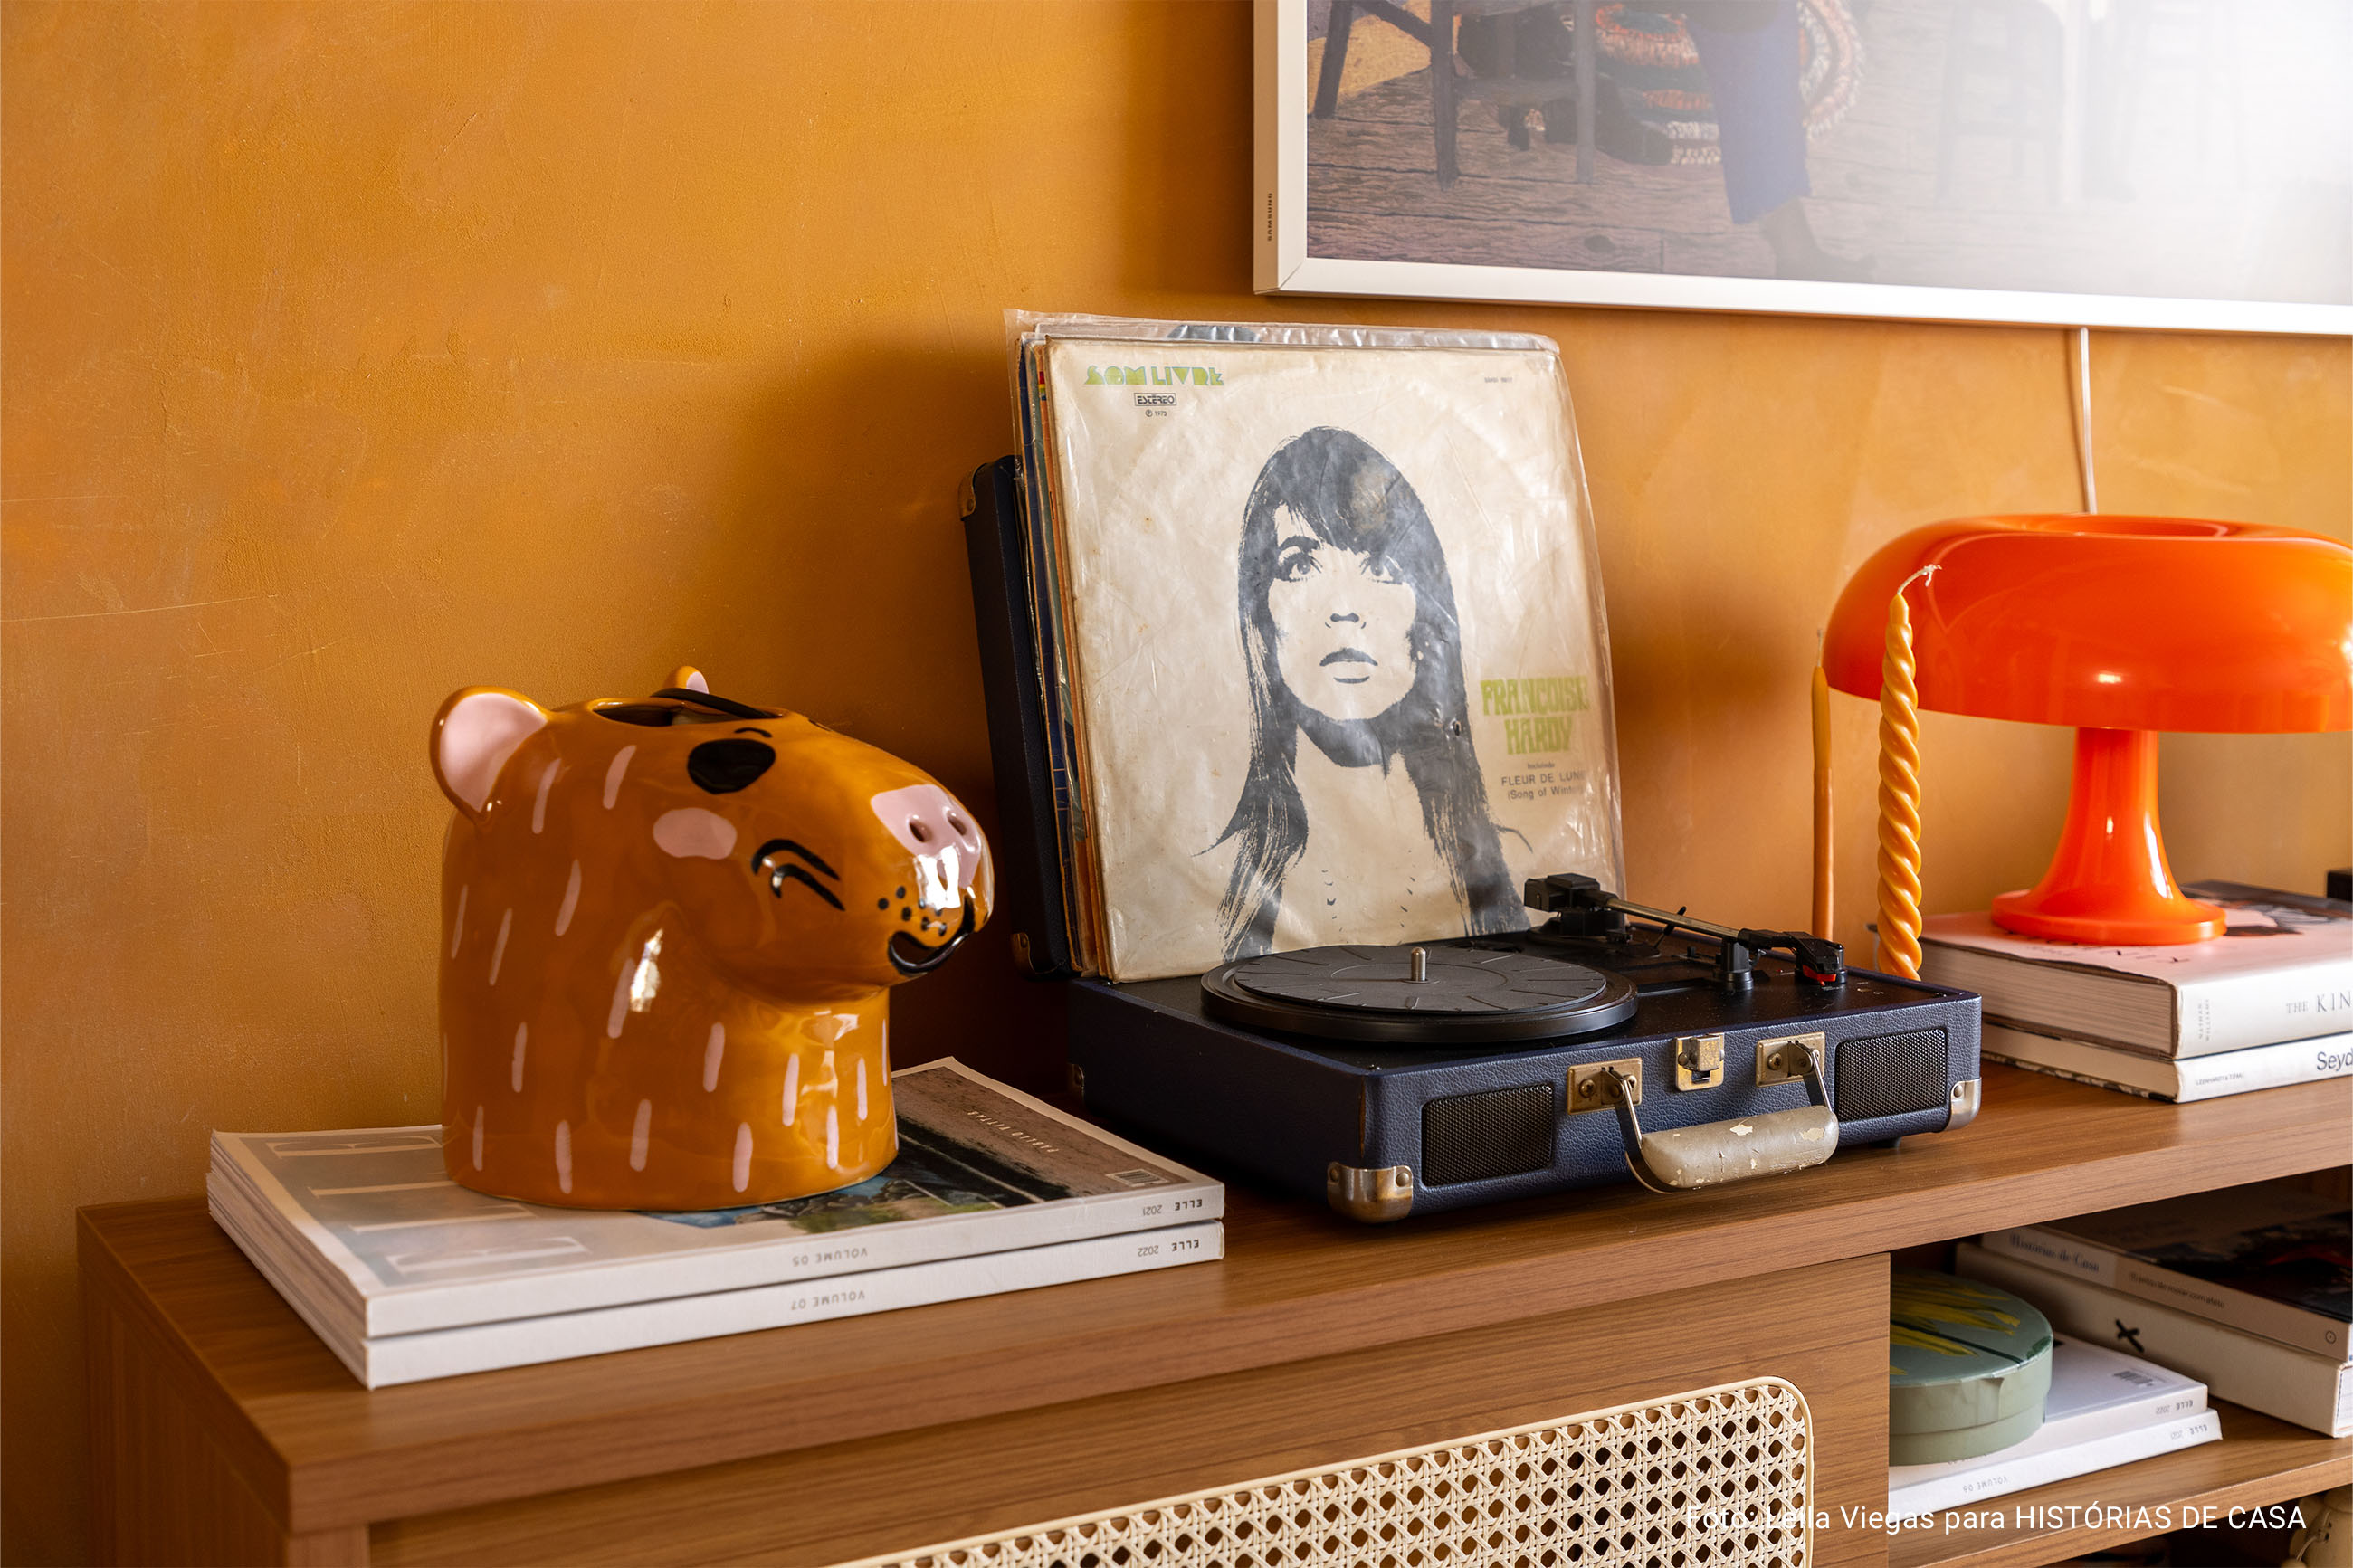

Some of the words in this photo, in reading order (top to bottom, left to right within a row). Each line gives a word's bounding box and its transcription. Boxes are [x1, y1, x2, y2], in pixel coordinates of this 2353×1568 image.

[1084, 365, 1148, 385] SOM
[1150, 366, 1224, 386] LIVRE
[1503, 716, 1573, 755] HARDY
[1501, 775, 1536, 786] FLEUR
[1540, 773, 1555, 783] DE
[1507, 788, 1535, 803] (Song
[1538, 787, 1548, 797] of
[2285, 1001, 2309, 1014] THE
[1142, 1204, 1163, 1216] 2021
[1174, 1199, 1203, 1212] ELLE
[1138, 1244, 1159, 1257] 2022
[1171, 1239, 1200, 1252] ELLE
[792, 1255, 809, 1267] 05
[815, 1247, 868, 1264] VOLUME
[791, 1298, 806, 1311] 07
[813, 1290, 865, 1307] VOLUME
[2175, 1399, 2194, 1411] ELLE
[2190, 1424, 2208, 1435] ELLE
[1977, 1476, 2009, 1491] VOLUME
